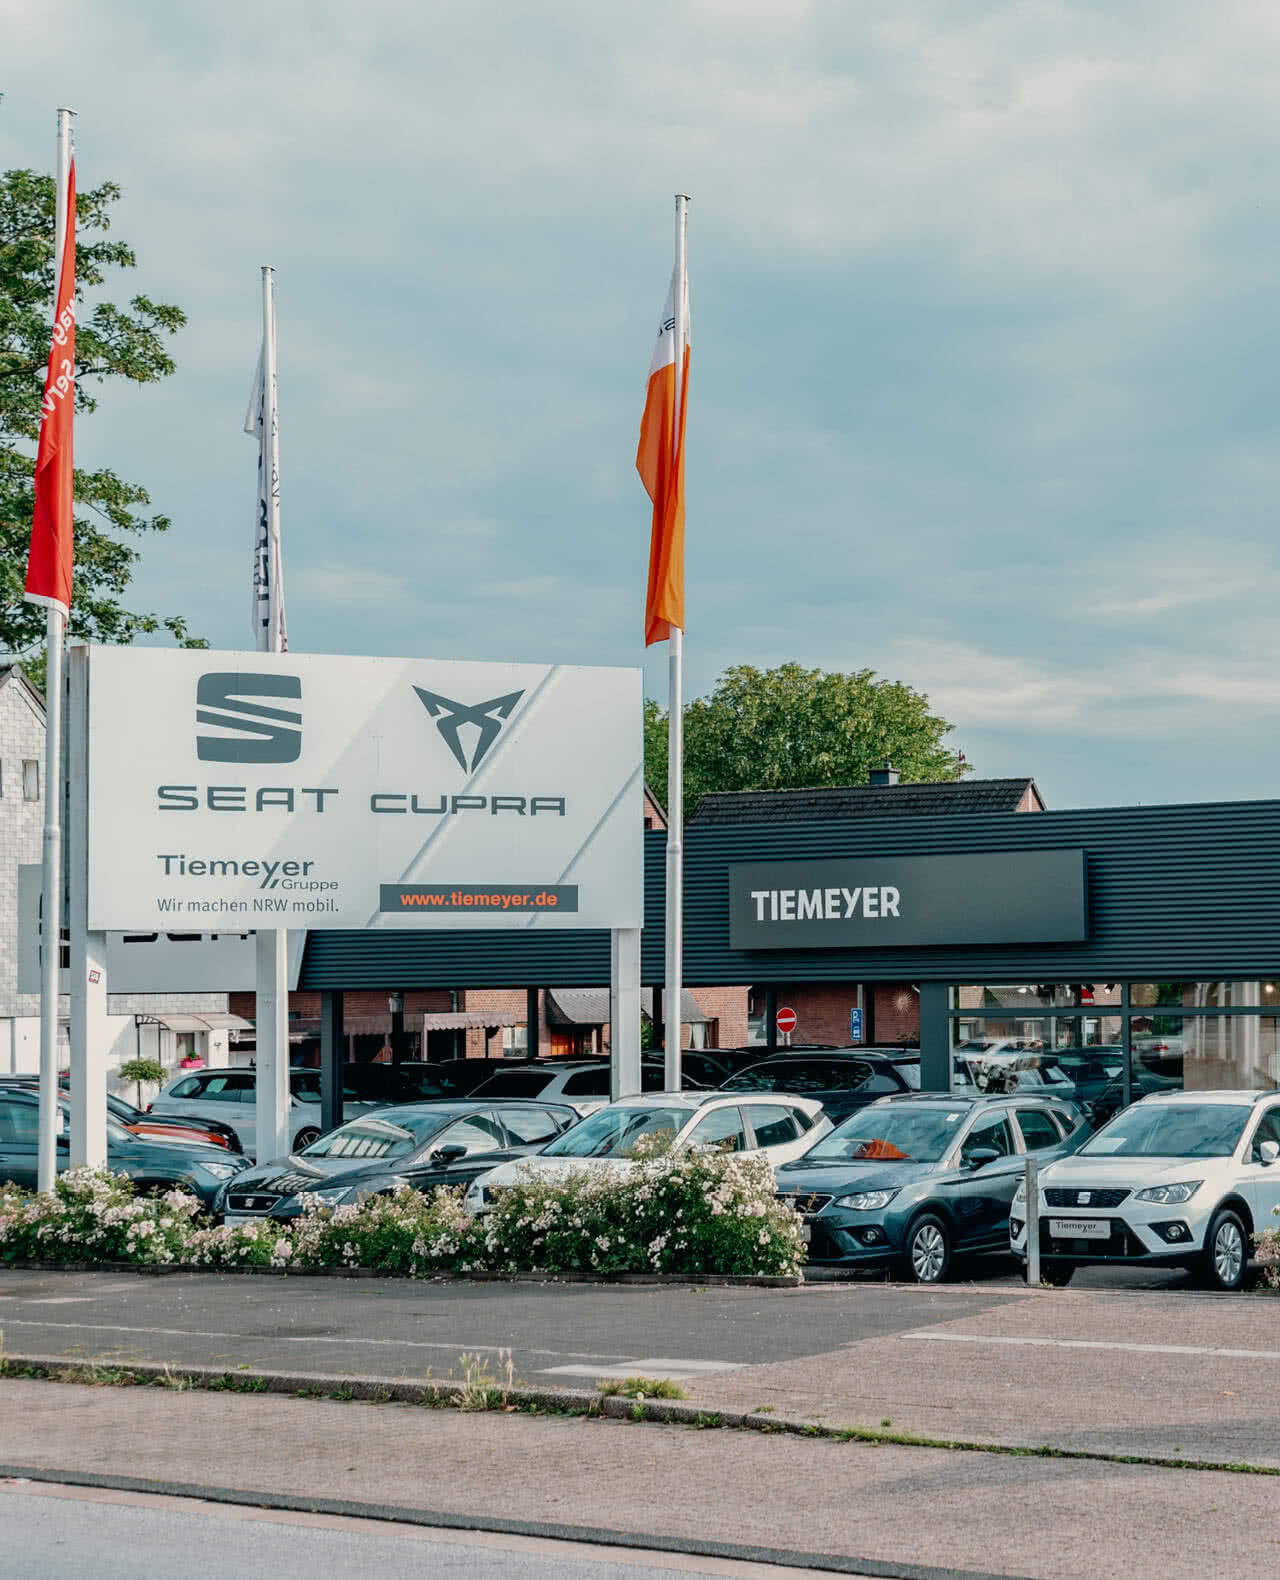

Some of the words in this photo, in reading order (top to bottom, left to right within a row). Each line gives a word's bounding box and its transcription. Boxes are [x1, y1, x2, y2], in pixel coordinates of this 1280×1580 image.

[157, 785, 339, 813] SEAT
[370, 793, 566, 817] CUPRA
[157, 854, 314, 889] Tiemeyer
[281, 878, 339, 892] Gruppe
[157, 898, 183, 912] Wir
[187, 898, 248, 912] machen
[253, 898, 288, 912] NRW
[292, 898, 340, 912] mobil.
[400, 891, 558, 909] www.tiemeyer.de
[751, 886, 900, 921] TIEMEYER
[1055, 1221, 1097, 1233] Tiemeyer
